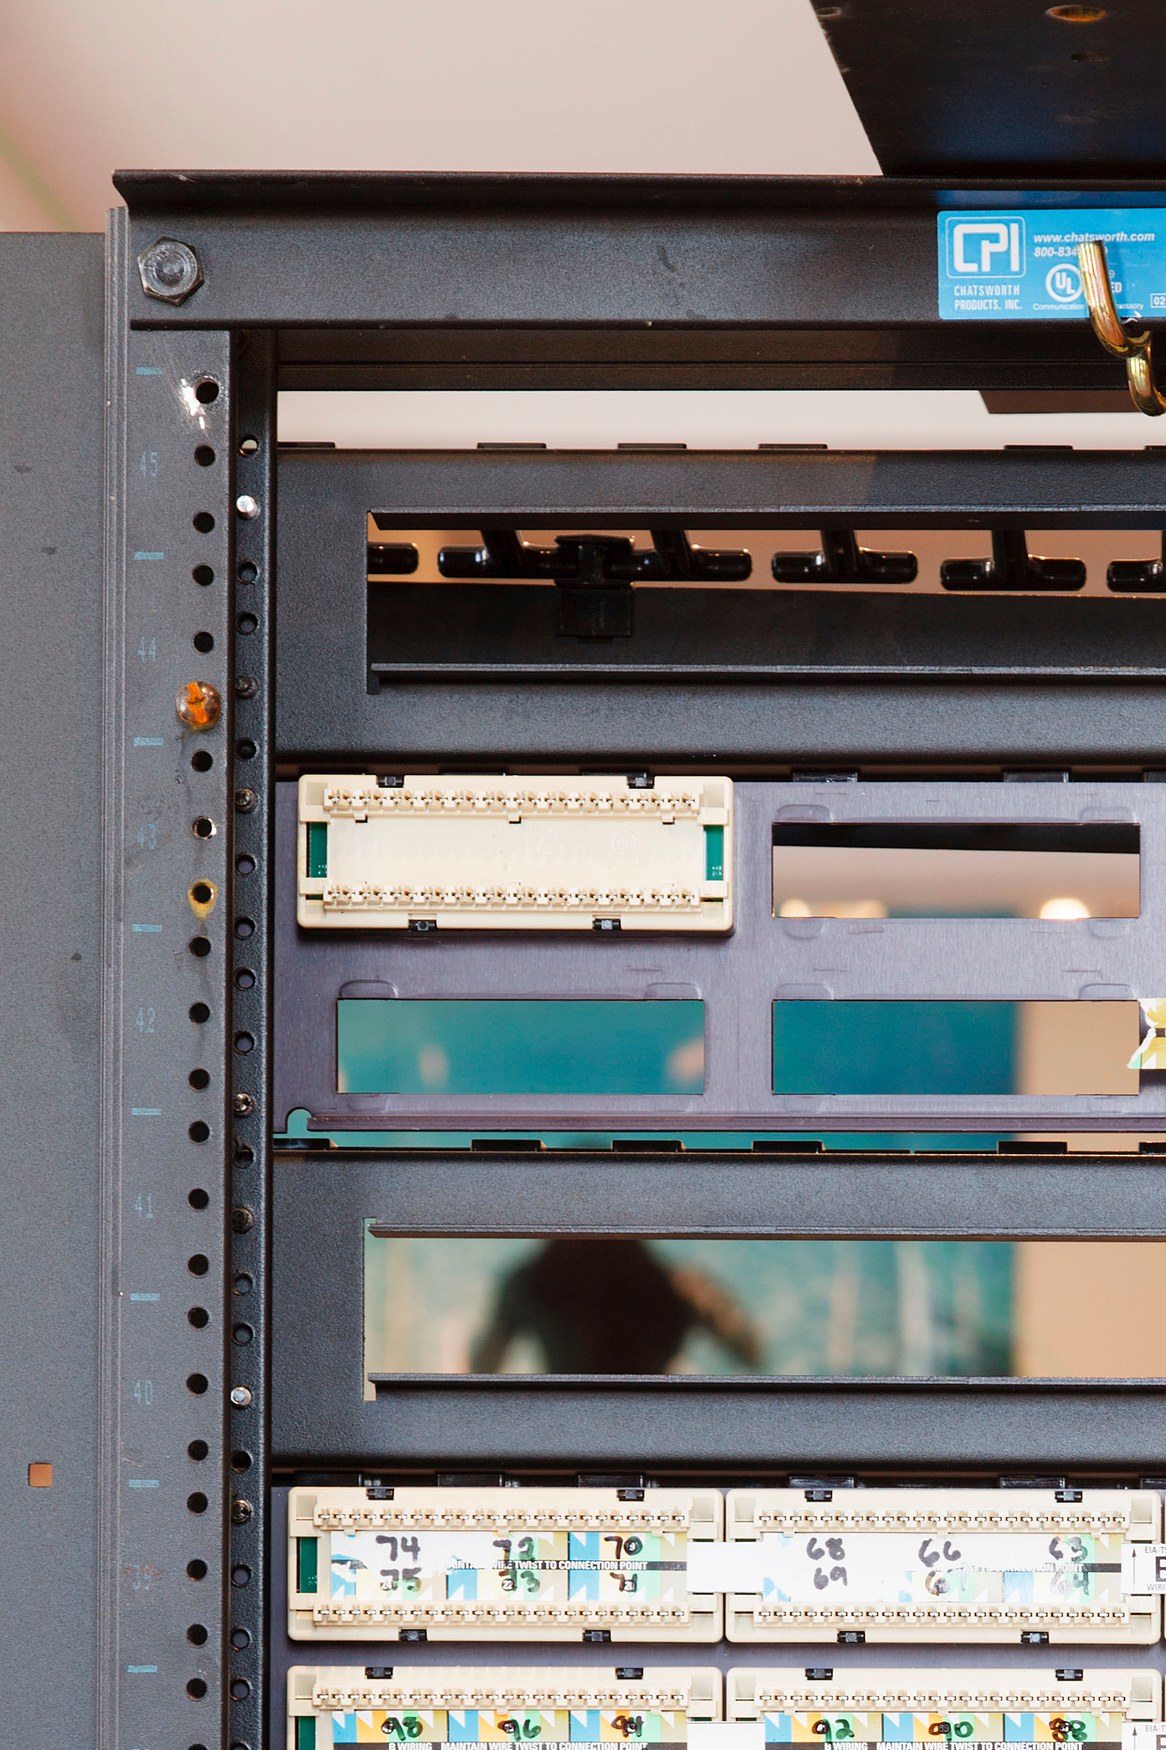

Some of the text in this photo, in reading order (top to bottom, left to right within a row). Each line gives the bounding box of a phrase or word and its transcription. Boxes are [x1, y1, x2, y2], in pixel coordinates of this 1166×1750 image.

[953, 223, 1020, 272] CPI
[953, 285, 1020, 297] CHATSWORTH
[1055, 272, 1075, 295] UL
[1004, 299, 1023, 310] INC.
[1153, 296, 1166, 306] 02
[139, 451, 158, 478] 45
[138, 637, 157, 663] 44
[136, 1008, 155, 1034] 42
[135, 1193, 153, 1219] 41
[134, 1379, 152, 1405] 40
[375, 1535, 421, 1562] 74
[603, 1536, 643, 1560] 70
[807, 1537, 845, 1561] 68
[918, 1538, 961, 1567] 66
[514, 1562, 648, 1570] TWIST TO CONNECTION POINT
[814, 1566, 848, 1590] 69
[380, 1567, 422, 1591] 75
[380, 1716, 423, 1741] 98
[497, 1719, 541, 1742] 96
[611, 1715, 645, 1738] 94
[812, 1718, 855, 1743] 92
[928, 1720, 974, 1742] 90
[398, 1742, 433, 1750] WIRING
[441, 1742, 488, 1750] MAINTAIN
[488, 1742, 513, 1750] WIRE
[514, 1742, 544, 1750] TWIST
[545, 1742, 557, 1750] TO
[558, 1742, 619, 1750] CONNECTION
[620, 1742, 648, 1750] POINT
